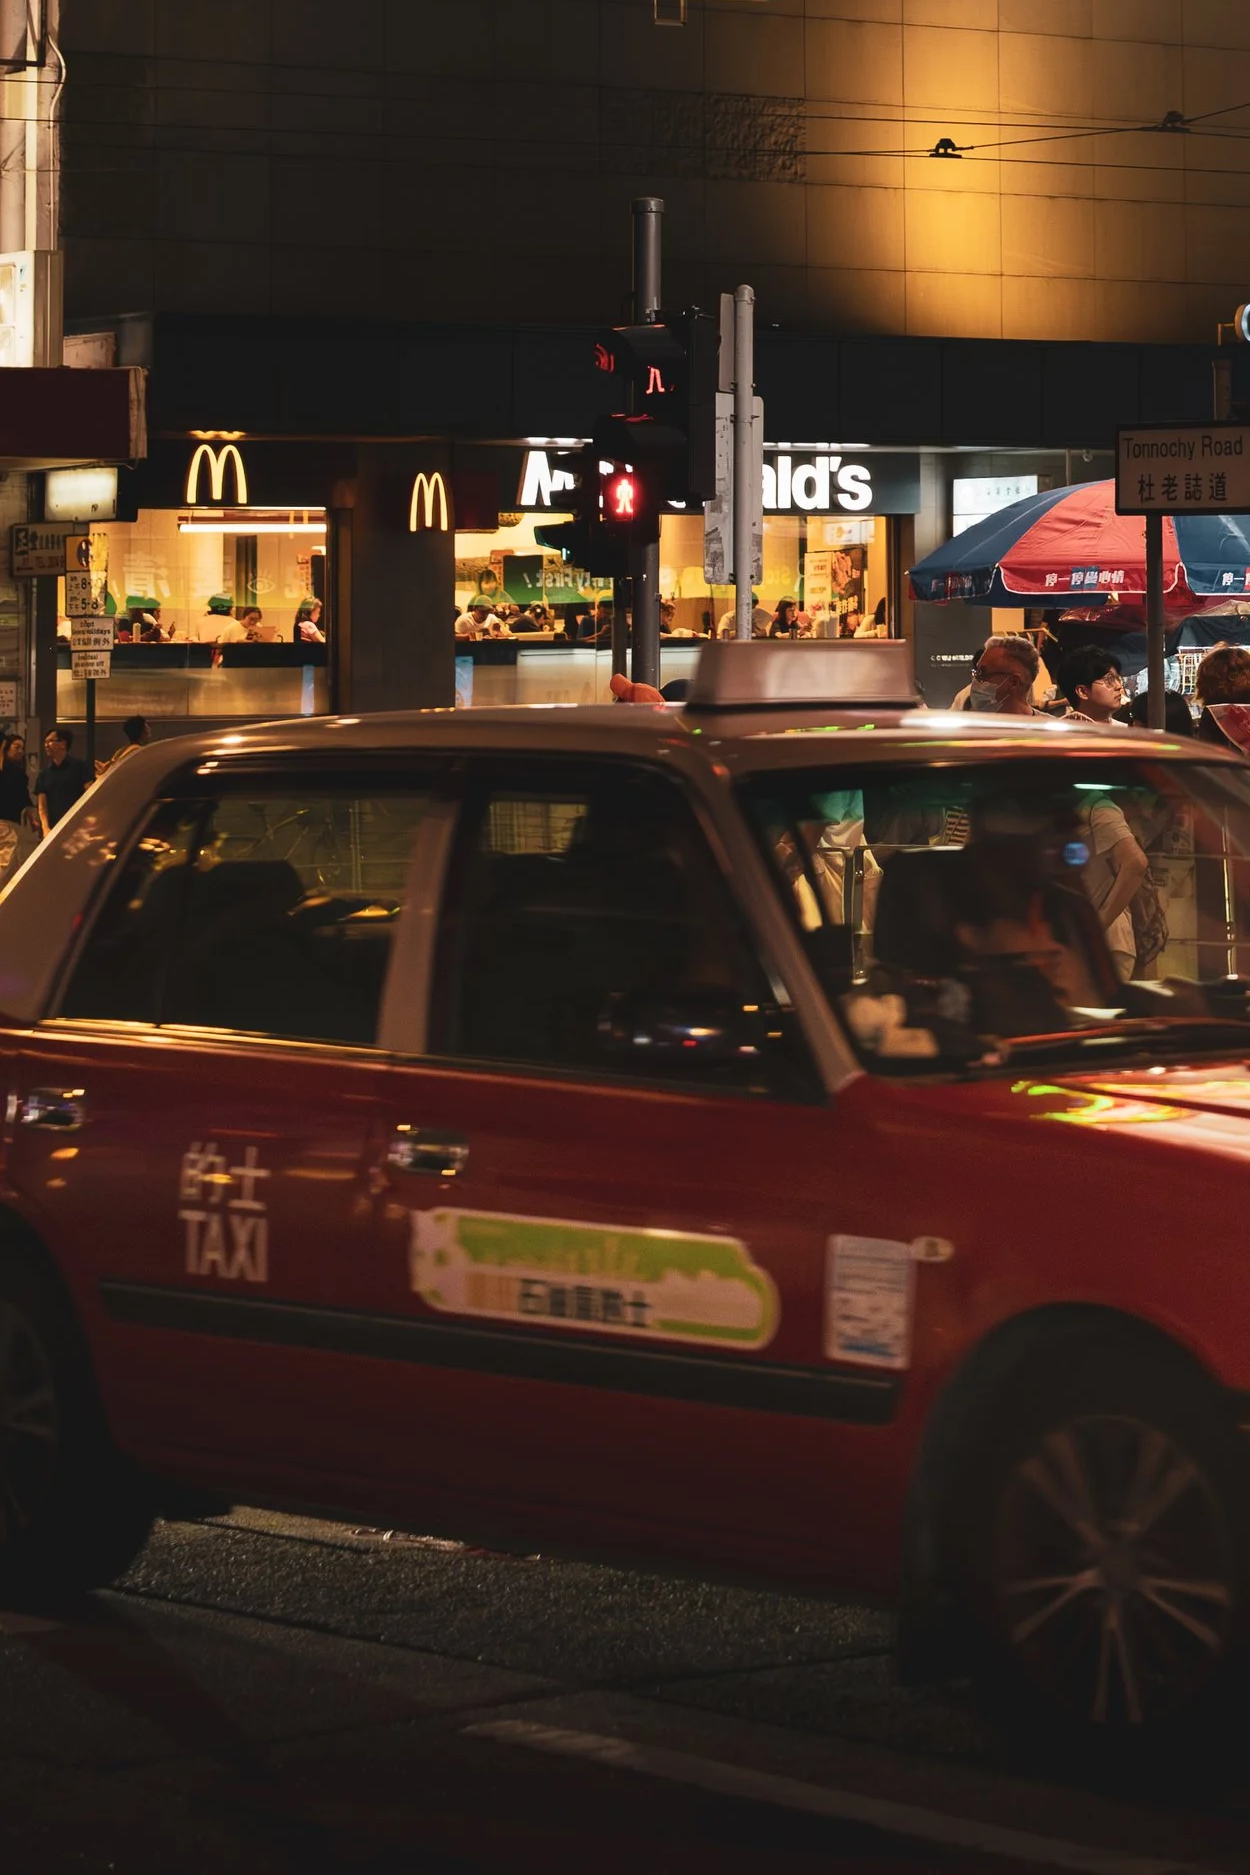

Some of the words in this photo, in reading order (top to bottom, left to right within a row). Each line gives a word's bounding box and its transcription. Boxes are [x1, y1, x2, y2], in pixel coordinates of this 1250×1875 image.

[1123, 438, 1195, 460] Tonnochy
[1202, 436, 1243, 456] Road
[1138, 473, 1228, 502] 杜老誌道
[177, 1209, 269, 1283] TAXI
